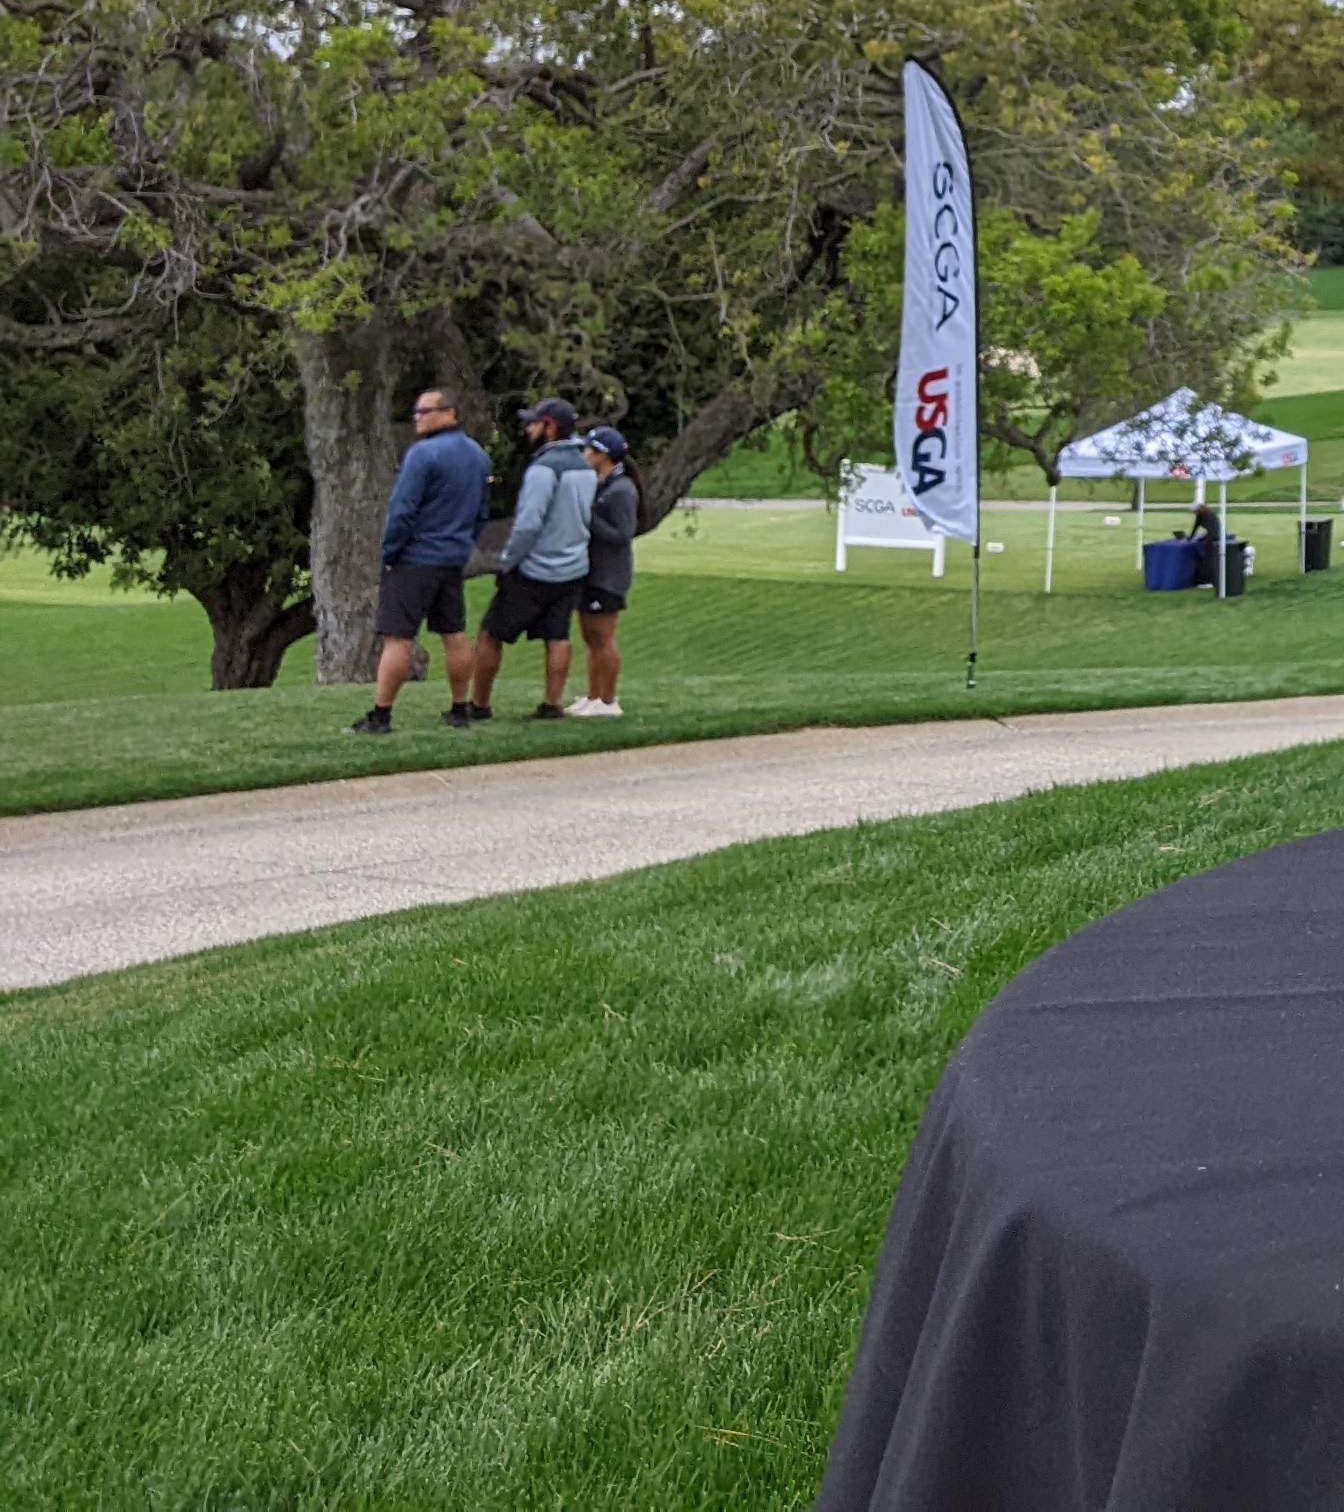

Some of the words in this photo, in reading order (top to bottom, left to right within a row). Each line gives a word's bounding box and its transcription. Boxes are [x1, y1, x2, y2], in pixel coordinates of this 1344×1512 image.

[933, 162, 960, 331] SCGA
[912, 368, 949, 496] USGA
[854, 498, 896, 514] SCGA
